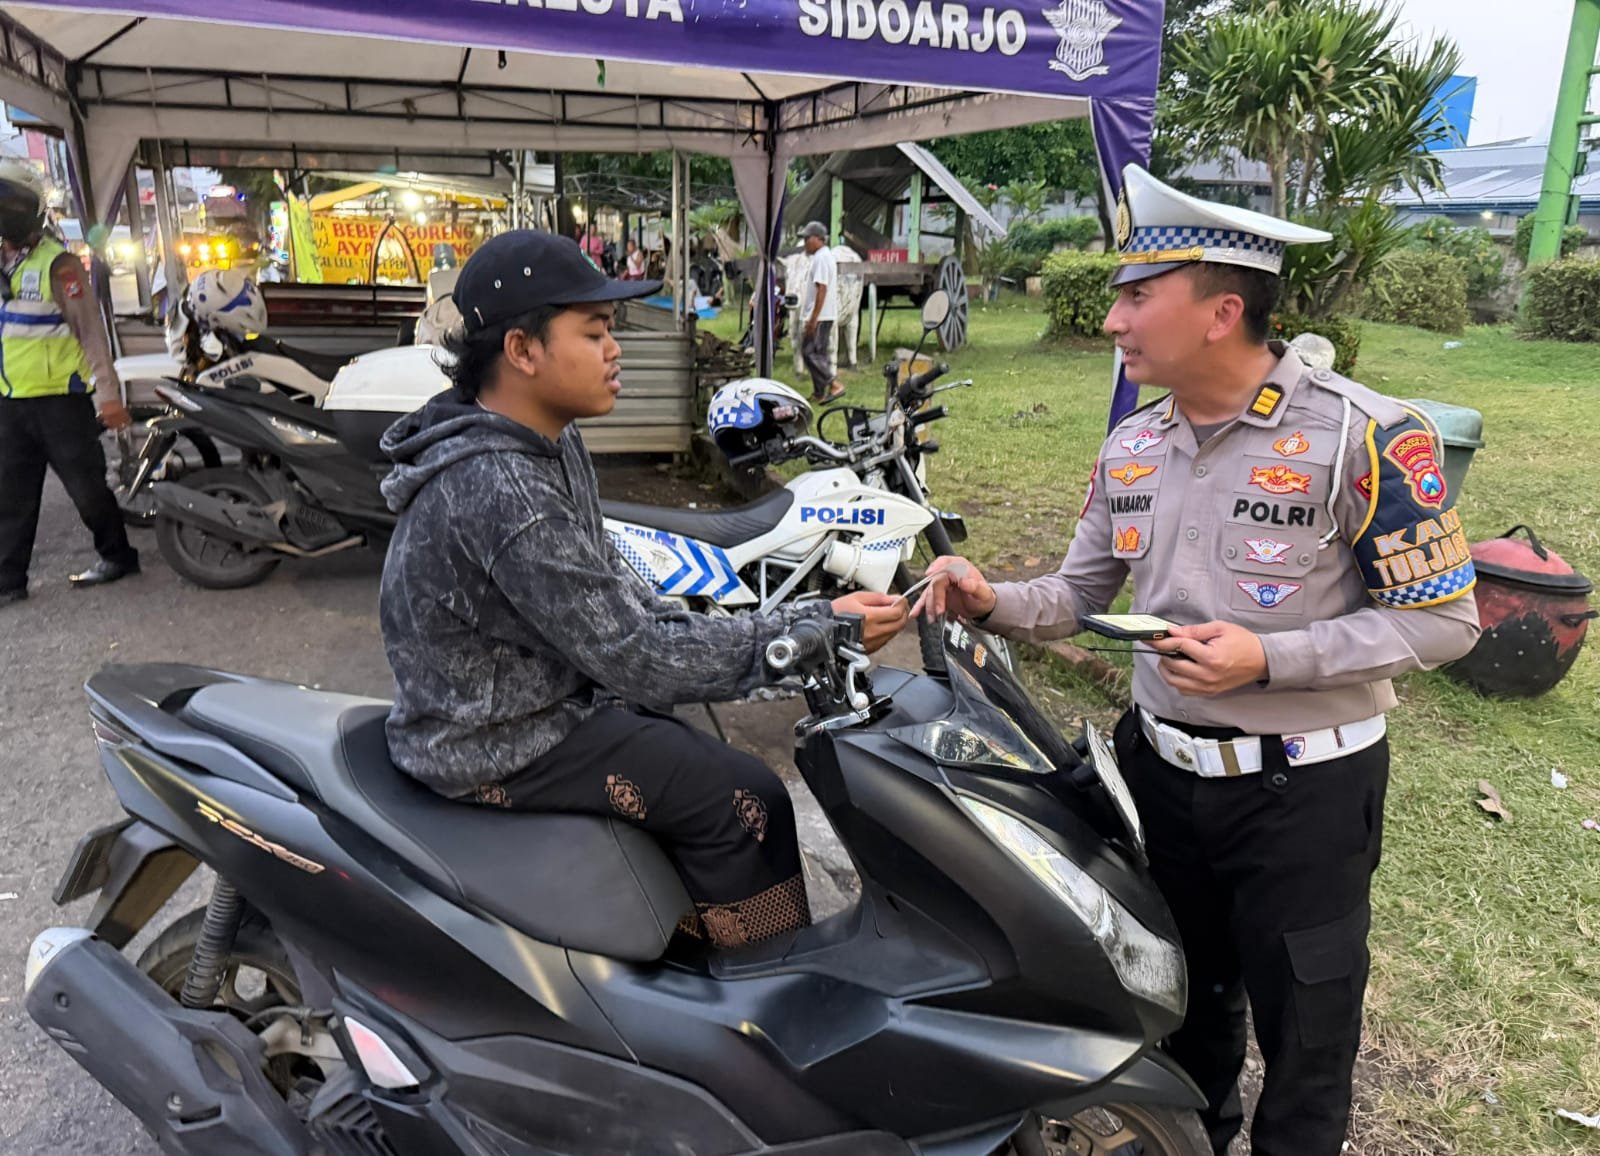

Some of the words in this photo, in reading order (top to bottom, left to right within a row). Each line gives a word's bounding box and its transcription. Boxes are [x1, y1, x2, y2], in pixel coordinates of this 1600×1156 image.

[799, 0, 1027, 55] SIDOARJO
[404, 225, 474, 240] GORENG
[209, 357, 254, 382] POLISI
[800, 506, 885, 526] POLISI
[1233, 498, 1316, 528] POLRI
